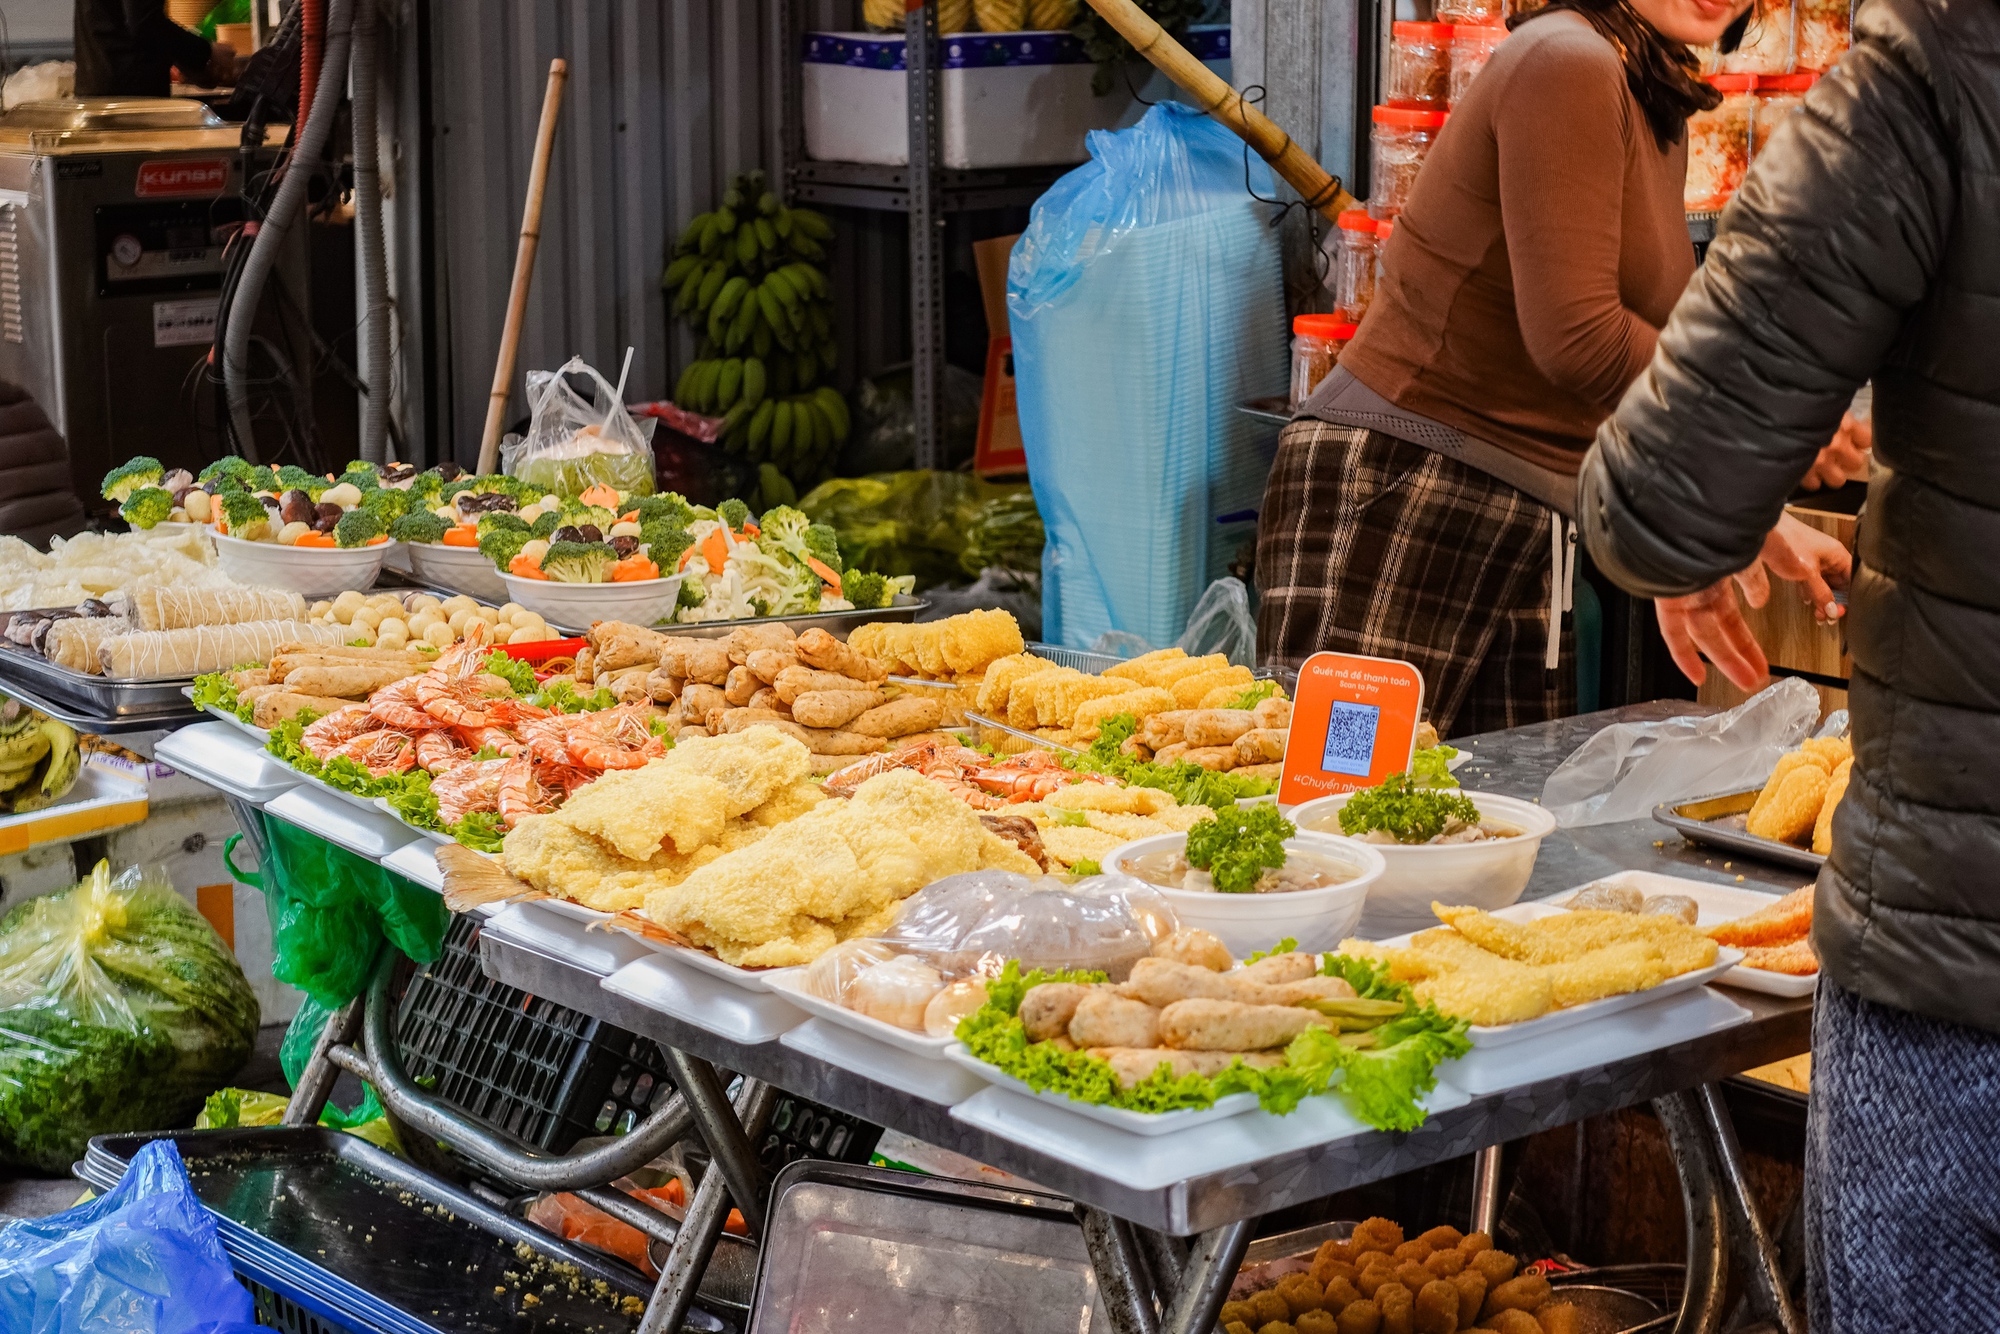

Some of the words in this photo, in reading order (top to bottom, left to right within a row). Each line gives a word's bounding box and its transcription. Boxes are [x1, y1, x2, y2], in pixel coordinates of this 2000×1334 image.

[1312, 665, 1334, 677] Quét
[1335, 669, 1349, 679] mã
[1363, 672, 1388, 684] thanh
[1390, 677, 1411, 687] toán
[1339, 680, 1356, 689] Scan
[1357, 683, 1365, 691] to
[1366, 684, 1379, 694] Pay
[1342, 782, 1373, 793] nhan
